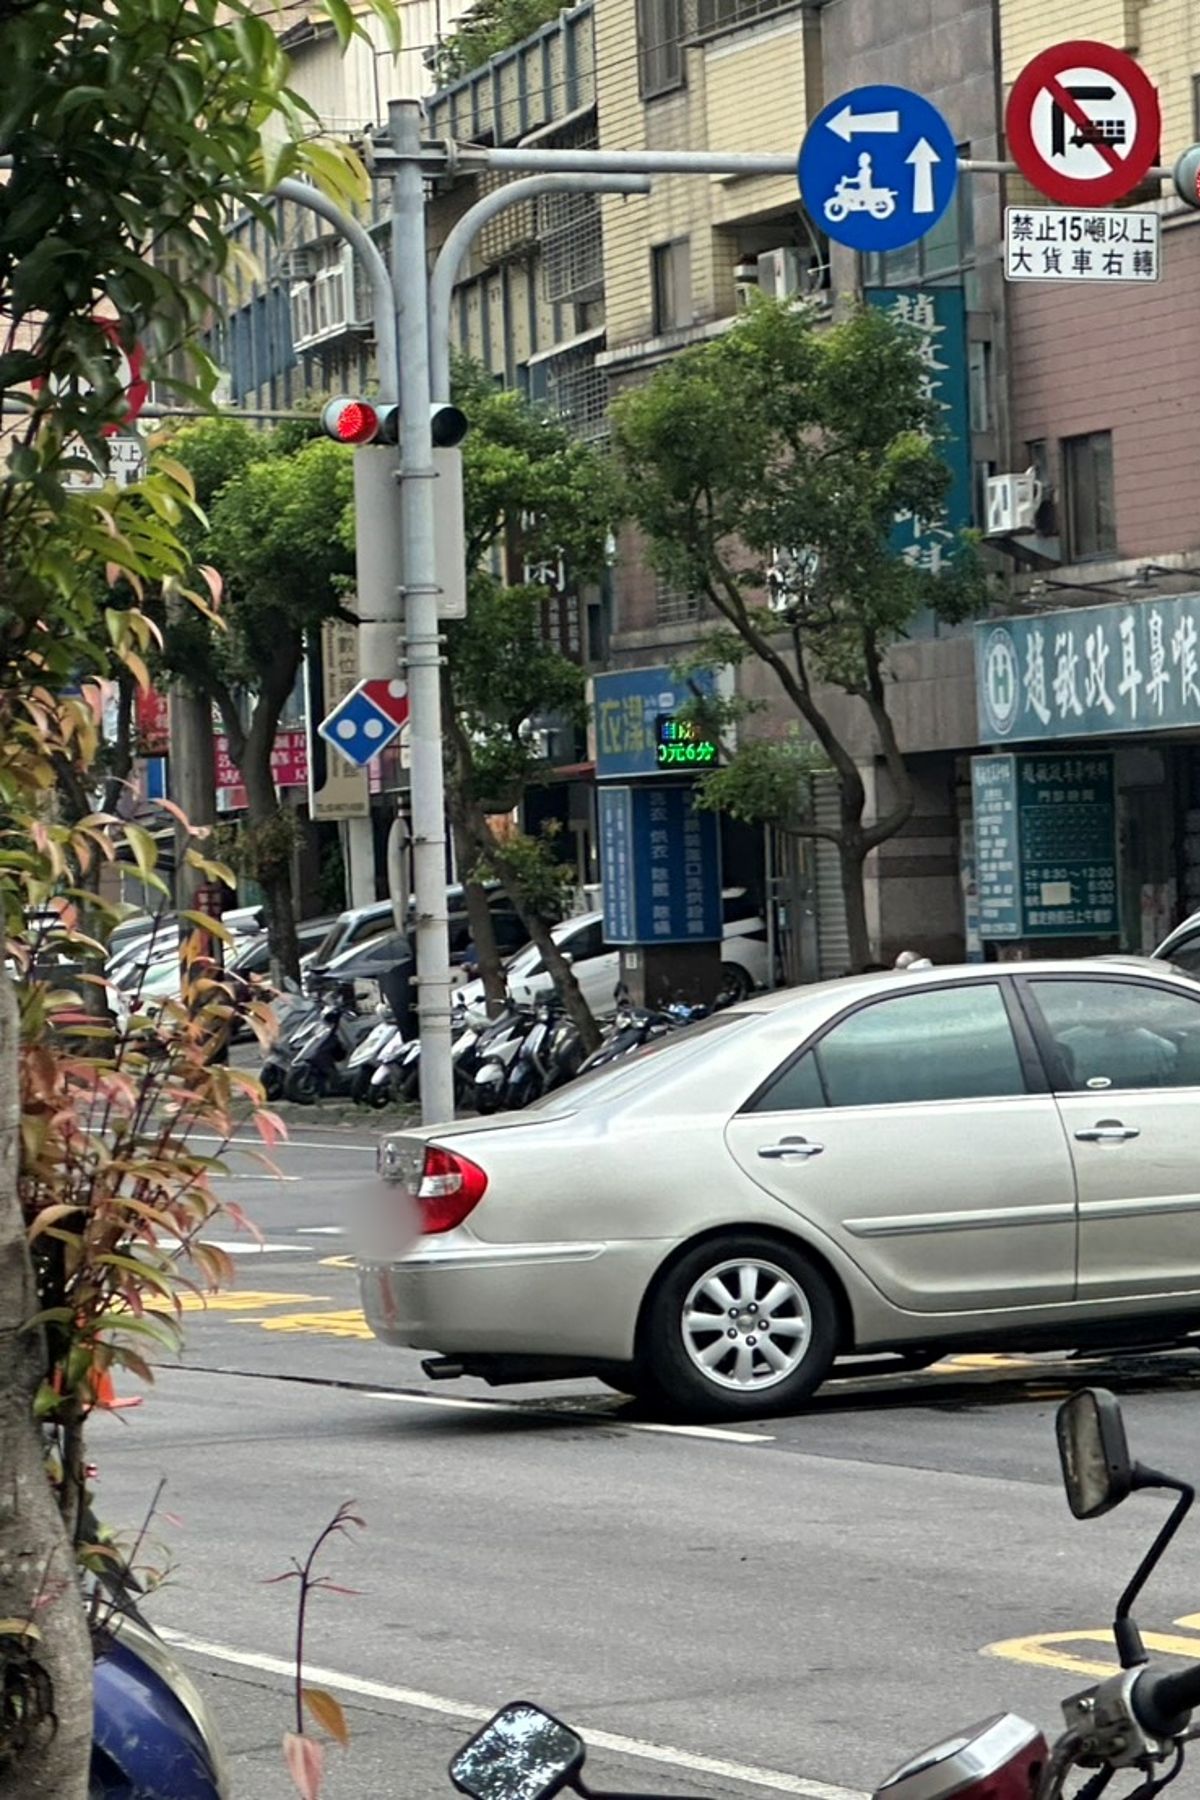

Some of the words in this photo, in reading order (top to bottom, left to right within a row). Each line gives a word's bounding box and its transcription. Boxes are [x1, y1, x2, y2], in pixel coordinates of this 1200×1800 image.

[1012, 213, 1154, 244] 禁止15噸以上
[1012, 246, 1154, 277] 大貨車右轉
